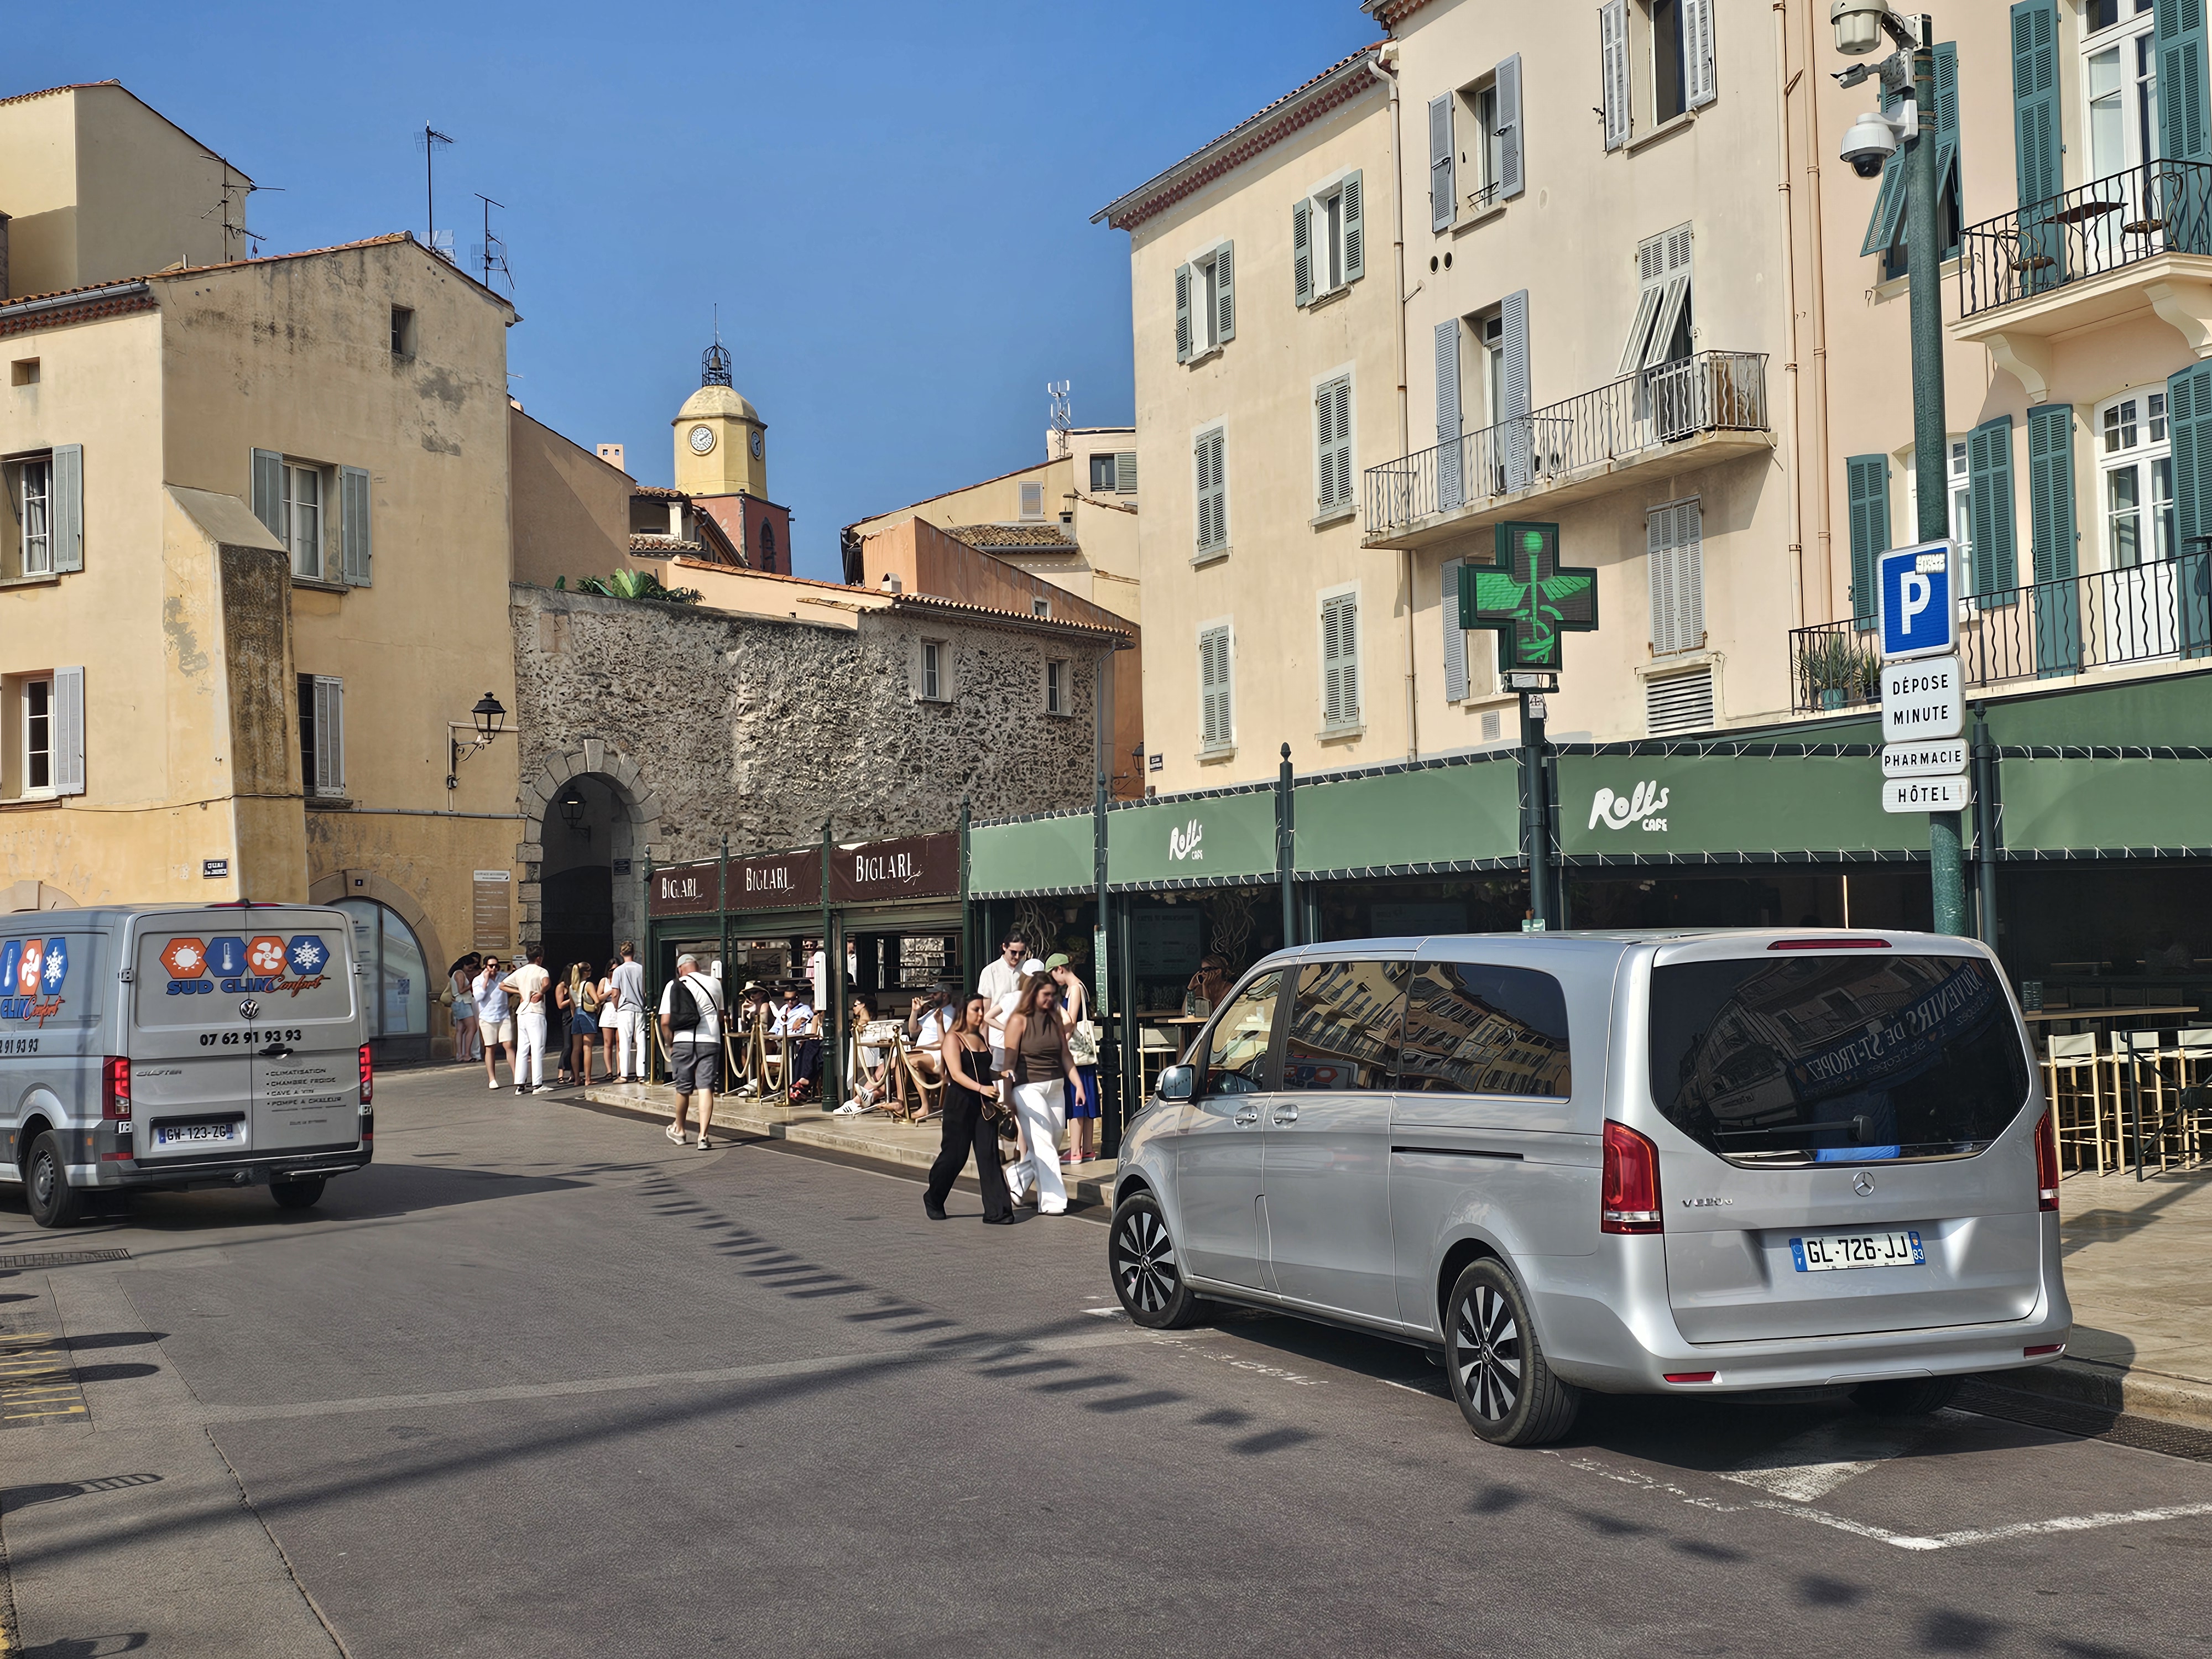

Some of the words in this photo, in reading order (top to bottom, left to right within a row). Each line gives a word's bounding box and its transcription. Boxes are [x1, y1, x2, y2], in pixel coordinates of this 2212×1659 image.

[1901, 570, 1931, 635] P
[1892, 674, 1948, 695] DÉPOSE
[1893, 705, 1948, 725] MINUTE
[1884, 750, 1961, 767] PHARMACIE
[1898, 784, 1950, 803] HÔTEL
[1588, 780, 1670, 830] Rolls
[1642, 818, 1668, 832] CAFE
[1168, 818, 1202, 860] Rolls
[855, 852, 911, 883] BIGLARI
[661, 877, 696, 899] BIGARI
[746, 867, 787, 891] BIGLARI
[166, 980, 214, 995] SUD
[220, 977, 274, 993] CLIM
[264, 974, 331, 998] Confort
[4, 1040, 14, 1054] 91
[200, 1033, 218, 1046] 07
[221, 1032, 239, 1045] 62
[243, 1031, 259, 1044] 91
[264, 1030, 281, 1043] 93
[285, 1029, 302, 1042] 93
[167, 1125, 227, 1140] GW-123-ZG
[1807, 1234, 1908, 1264] GL-726-JJ
[1913, 1249, 1924, 1260] 83
